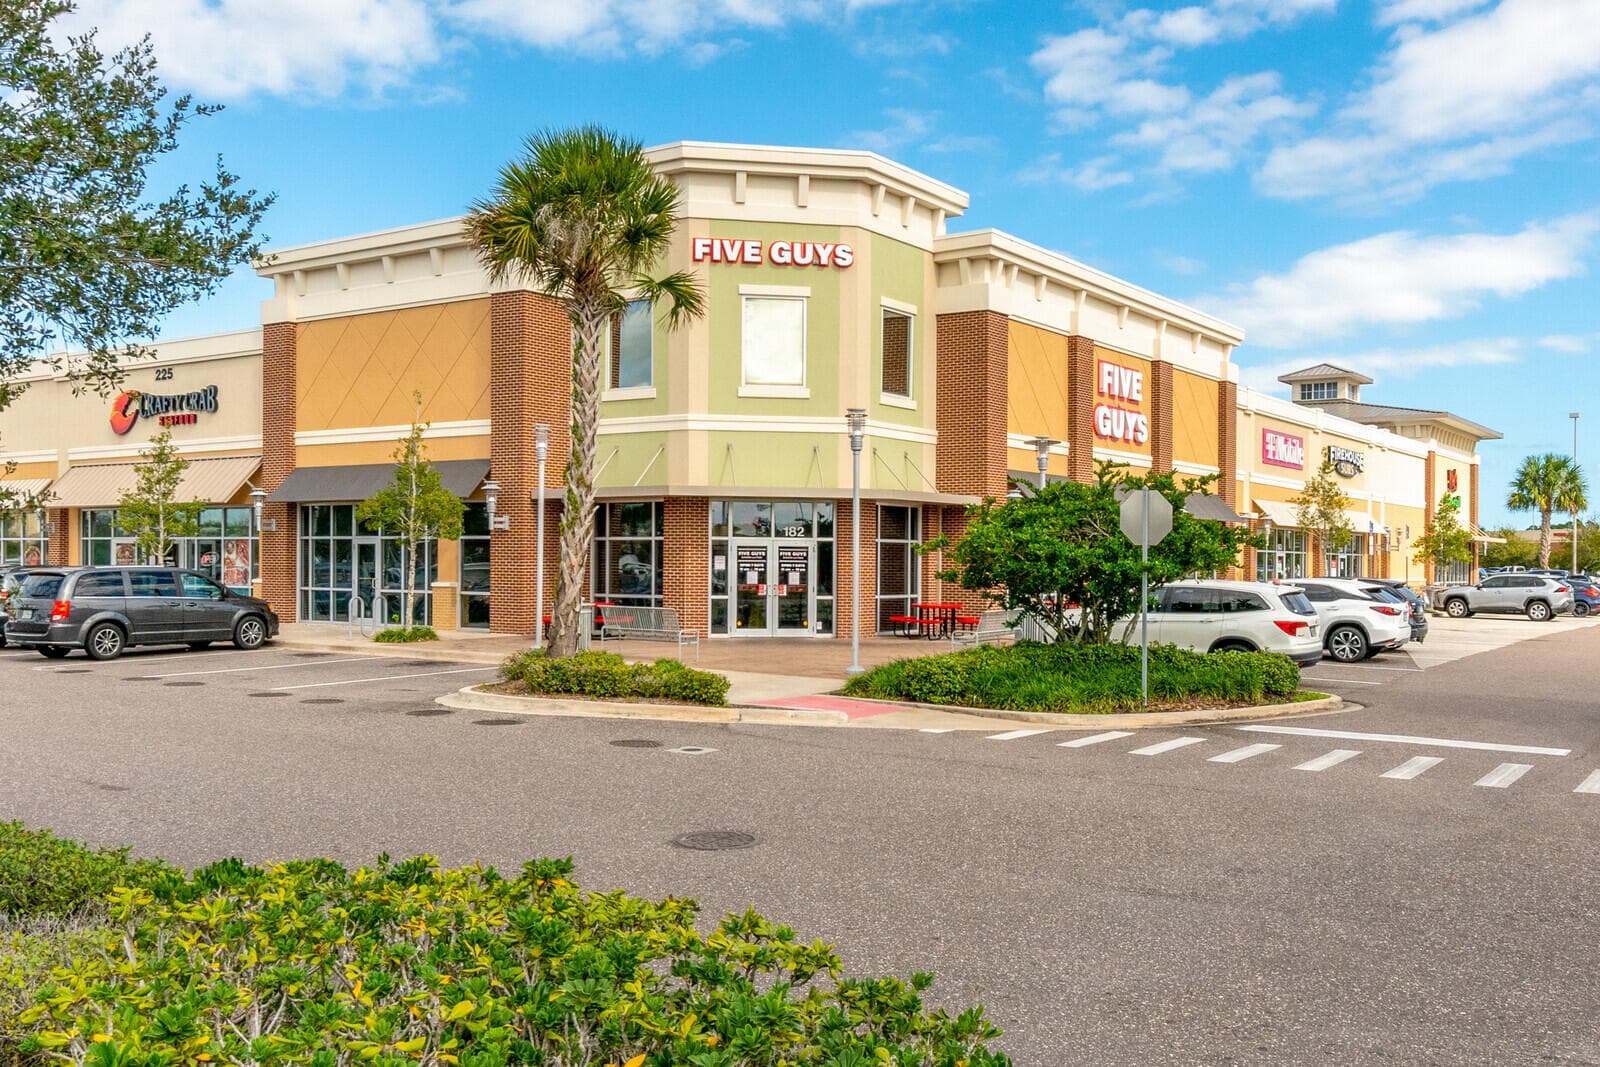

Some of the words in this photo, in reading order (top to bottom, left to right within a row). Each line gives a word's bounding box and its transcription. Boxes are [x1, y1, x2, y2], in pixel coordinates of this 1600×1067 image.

[692, 238, 762, 265] FIVE
[769, 241, 854, 269] GUYS
[155, 368, 173, 380] 225
[1097, 359, 1143, 405] FIVE
[139, 392, 186, 419] CRAFTY
[184, 385, 218, 413] CRAB
[1092, 402, 1148, 446] GUYS
[1328, 445, 1364, 473] FIREHOUSE
[784, 526, 805, 537] 182
